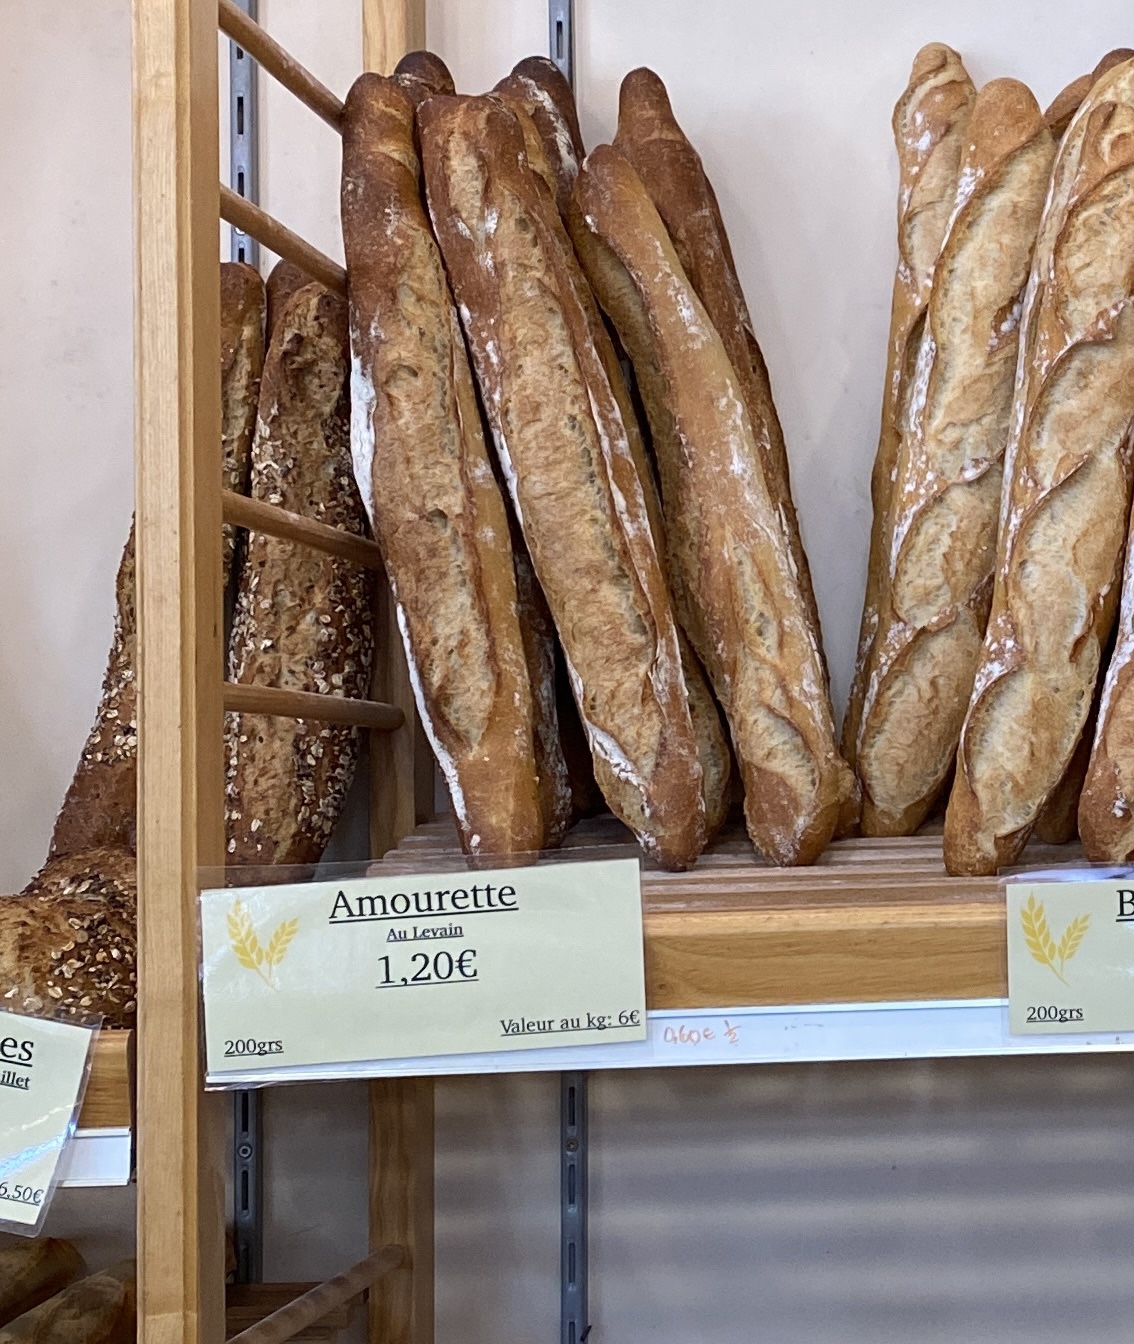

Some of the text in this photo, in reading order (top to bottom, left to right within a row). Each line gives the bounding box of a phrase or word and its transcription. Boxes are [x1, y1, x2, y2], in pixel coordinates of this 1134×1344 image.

[329, 883, 518, 922] Amourette
[386, 922, 464, 942] Au Levain
[377, 949, 478, 987] 1,20€
[500, 1009, 640, 1035] Valeur au kg: 6€
[1026, 1006, 1083, 1023] 200grs
[224, 1038, 284, 1057] 200grs
